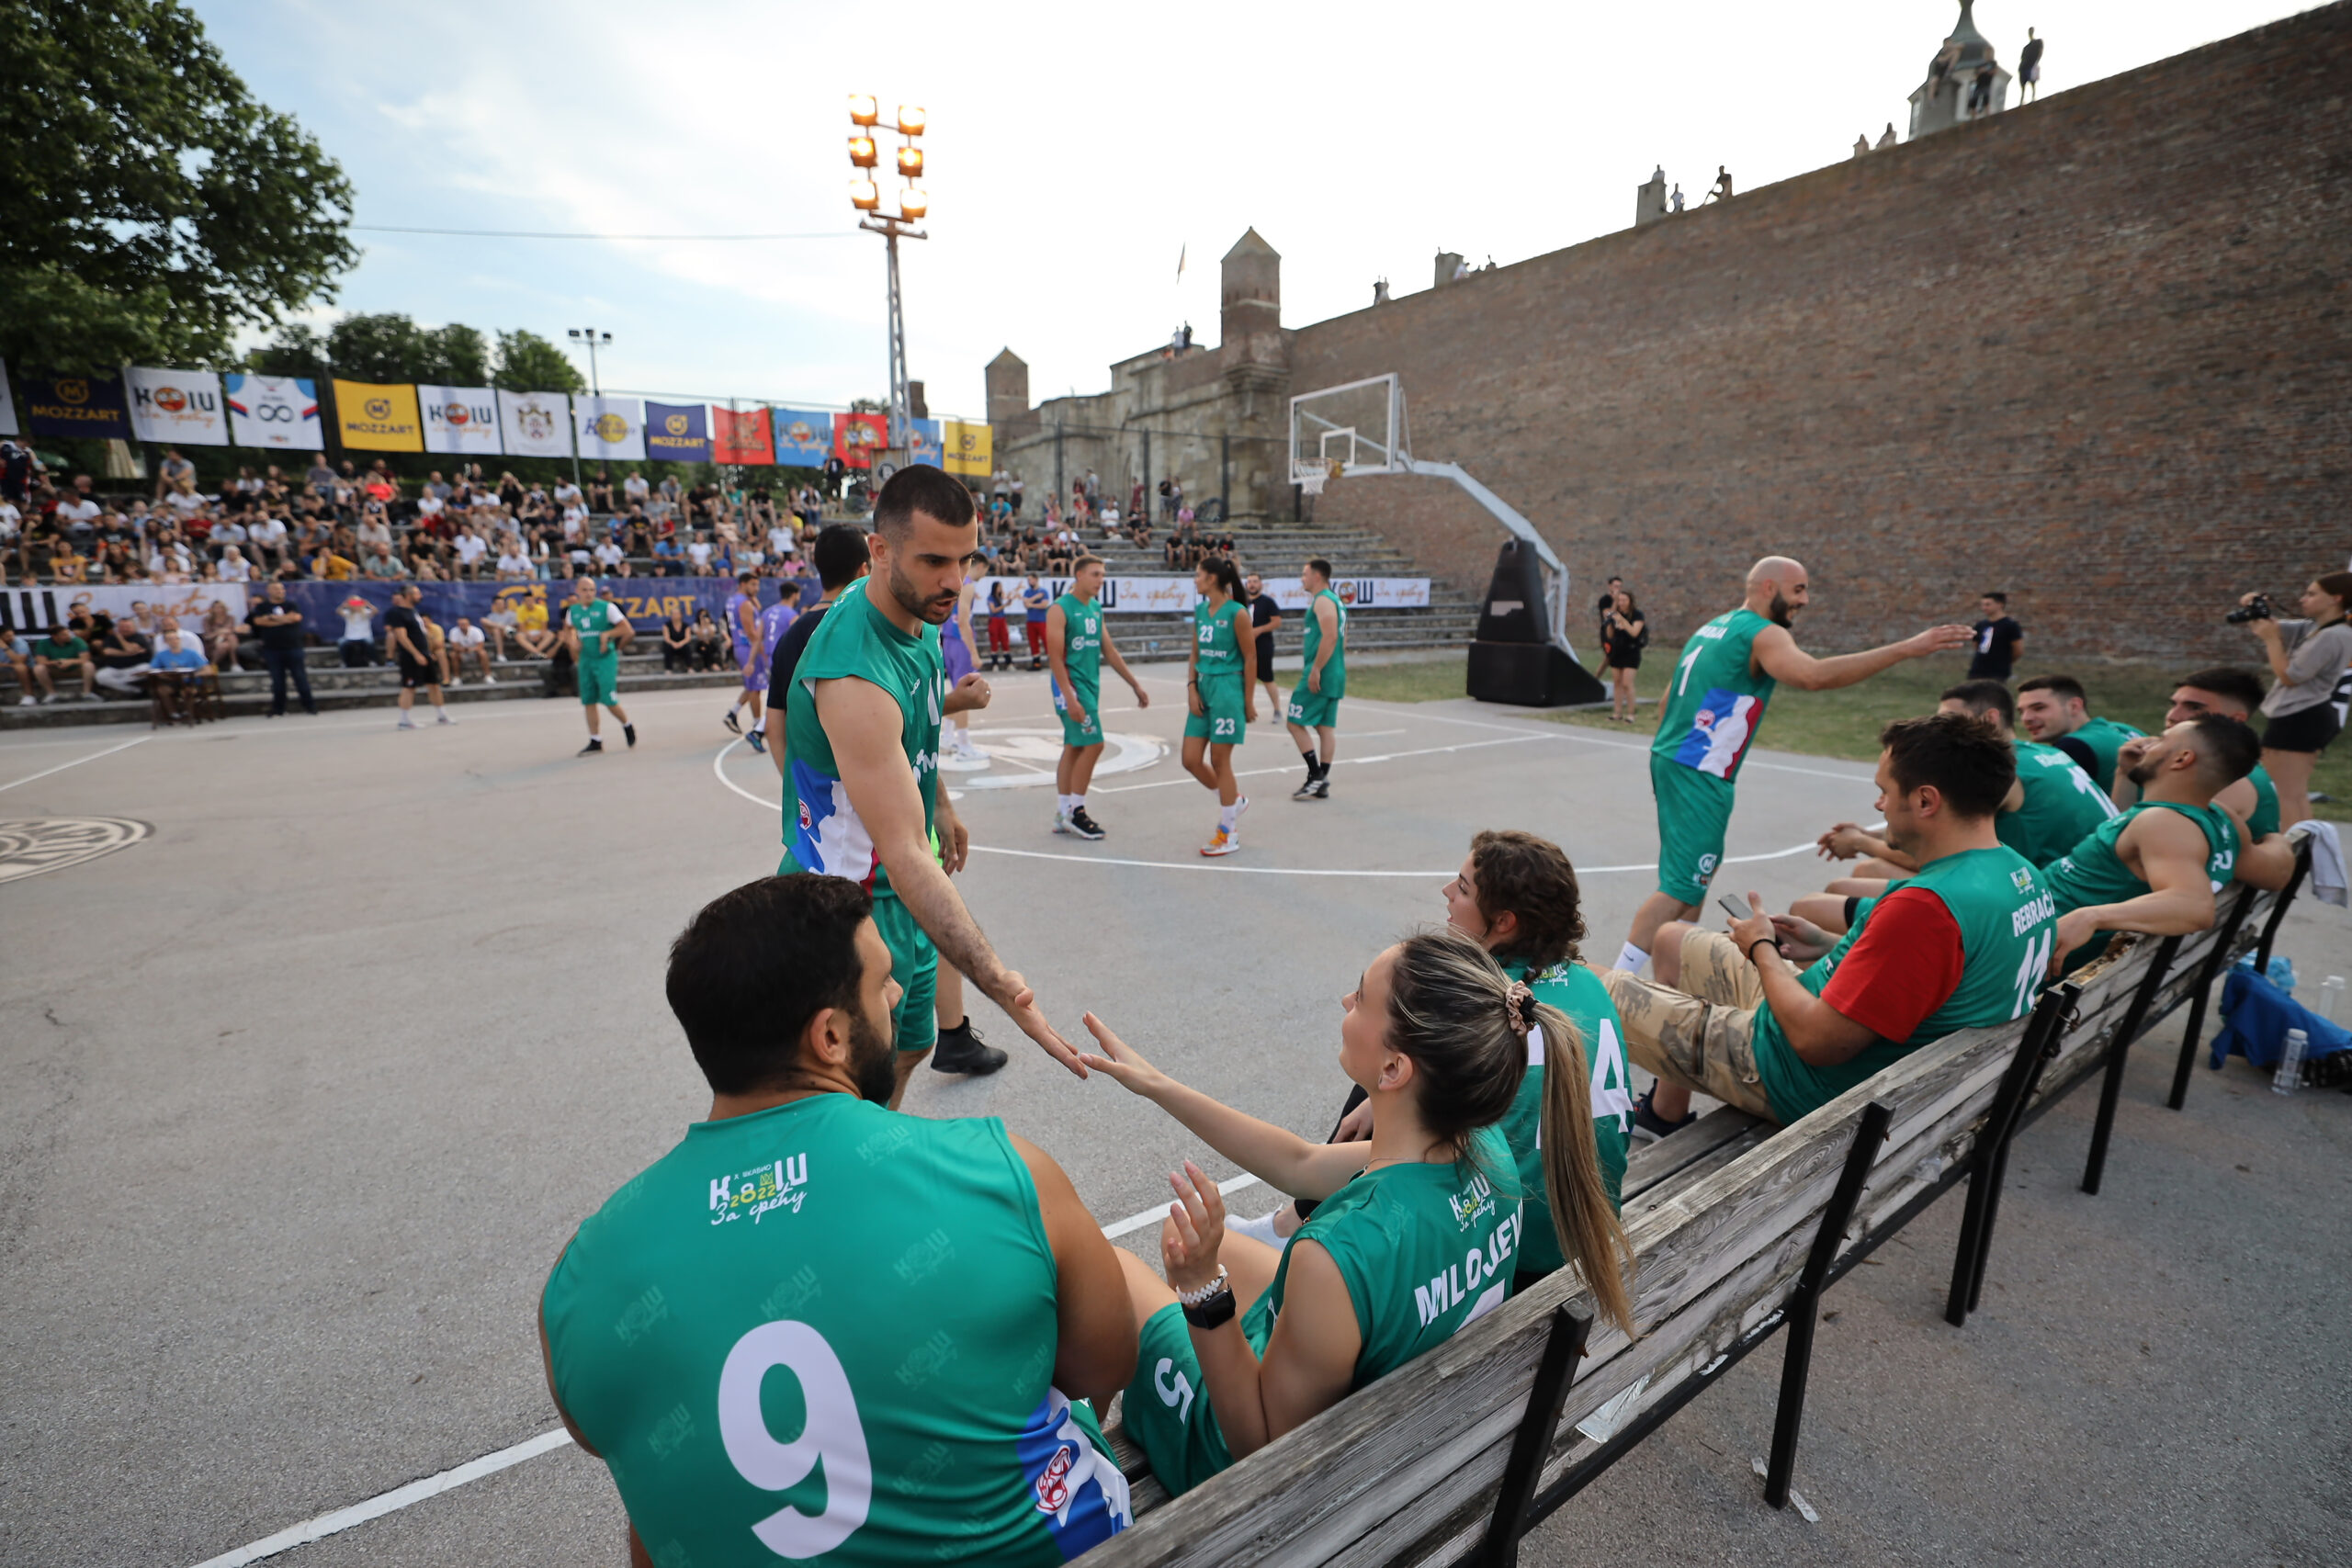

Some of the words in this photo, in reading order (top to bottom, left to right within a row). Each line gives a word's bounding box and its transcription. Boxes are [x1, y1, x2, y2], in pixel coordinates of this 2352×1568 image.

[31, 404, 120, 423] MOZZART
[346, 421, 415, 434] MOZZART
[650, 434, 707, 449] MOZZART
[946, 451, 989, 463] MOZZART
[1199, 625, 1214, 643] 23
[1679, 645, 1703, 696] 1
[1288, 703, 1303, 718] 32
[1216, 716, 1236, 736] 23
[711, 1201, 741, 1225] За
[749, 1181, 808, 1224] срећу
[730, 1184, 776, 1208] 2022
[718, 1320, 873, 1560] 9
